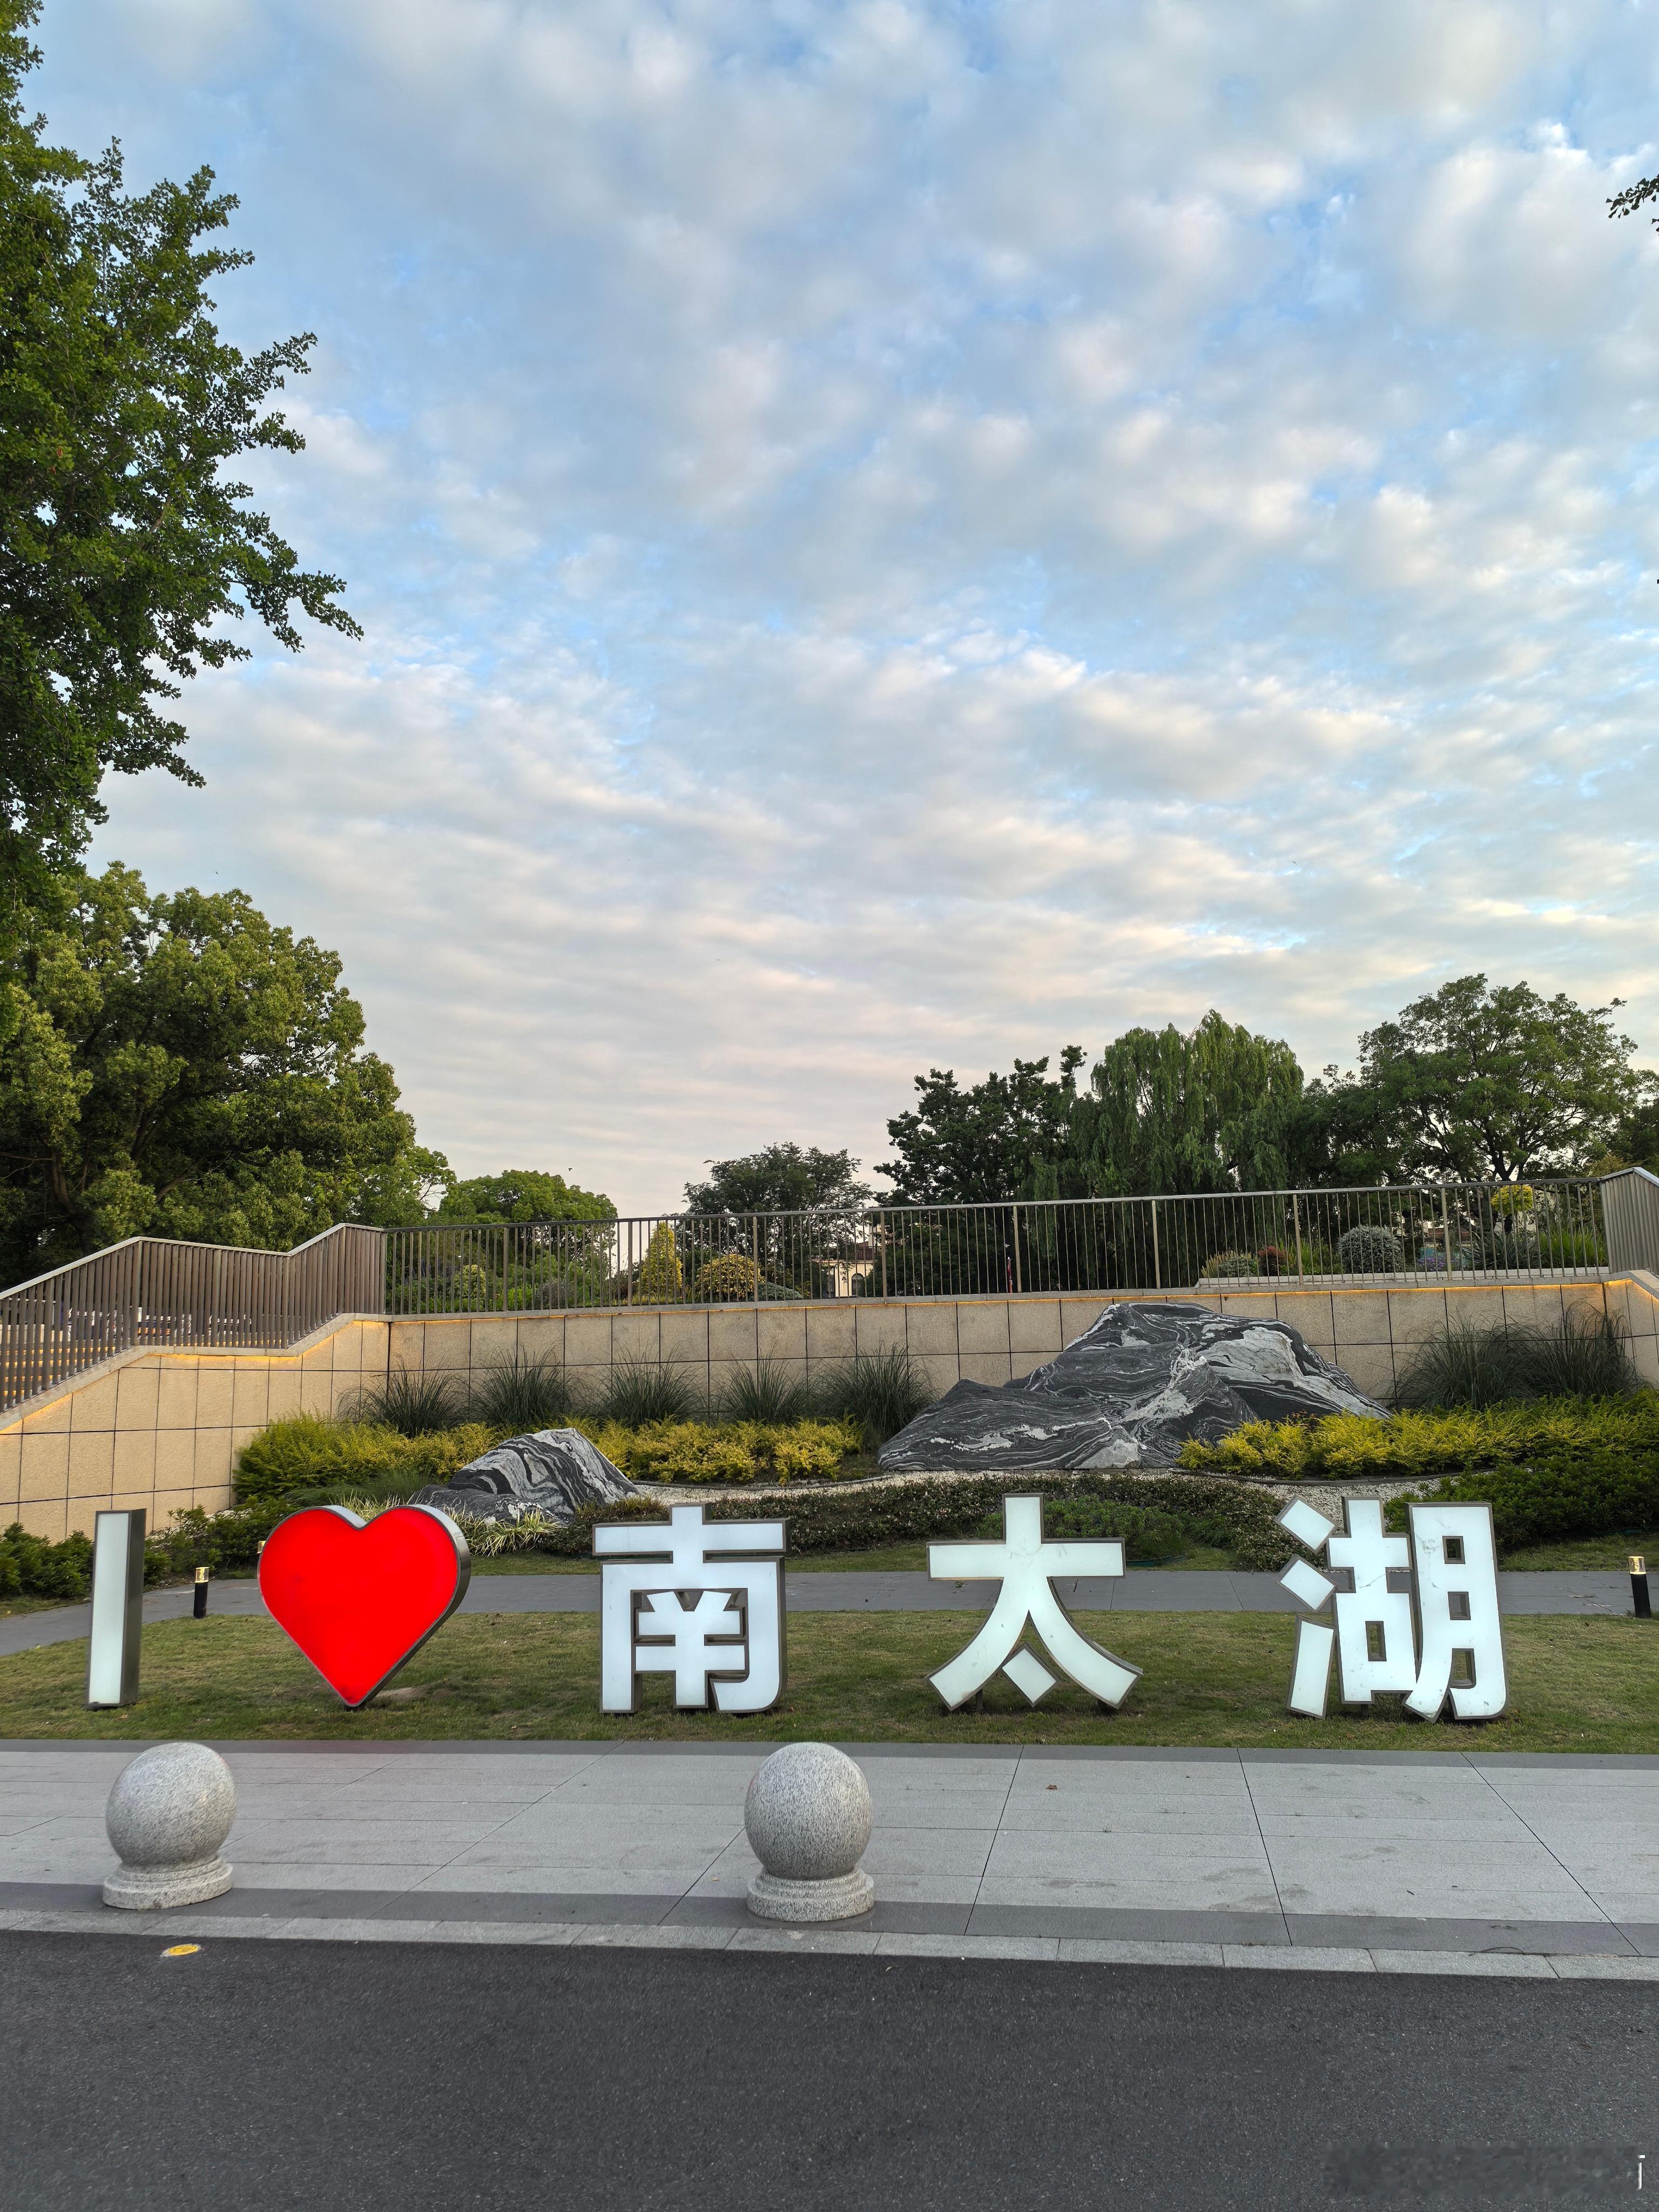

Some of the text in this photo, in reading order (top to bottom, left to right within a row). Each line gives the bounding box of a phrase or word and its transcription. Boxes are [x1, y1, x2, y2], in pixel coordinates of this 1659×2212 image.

[87, 1493, 1508, 1723] I 南太湖
